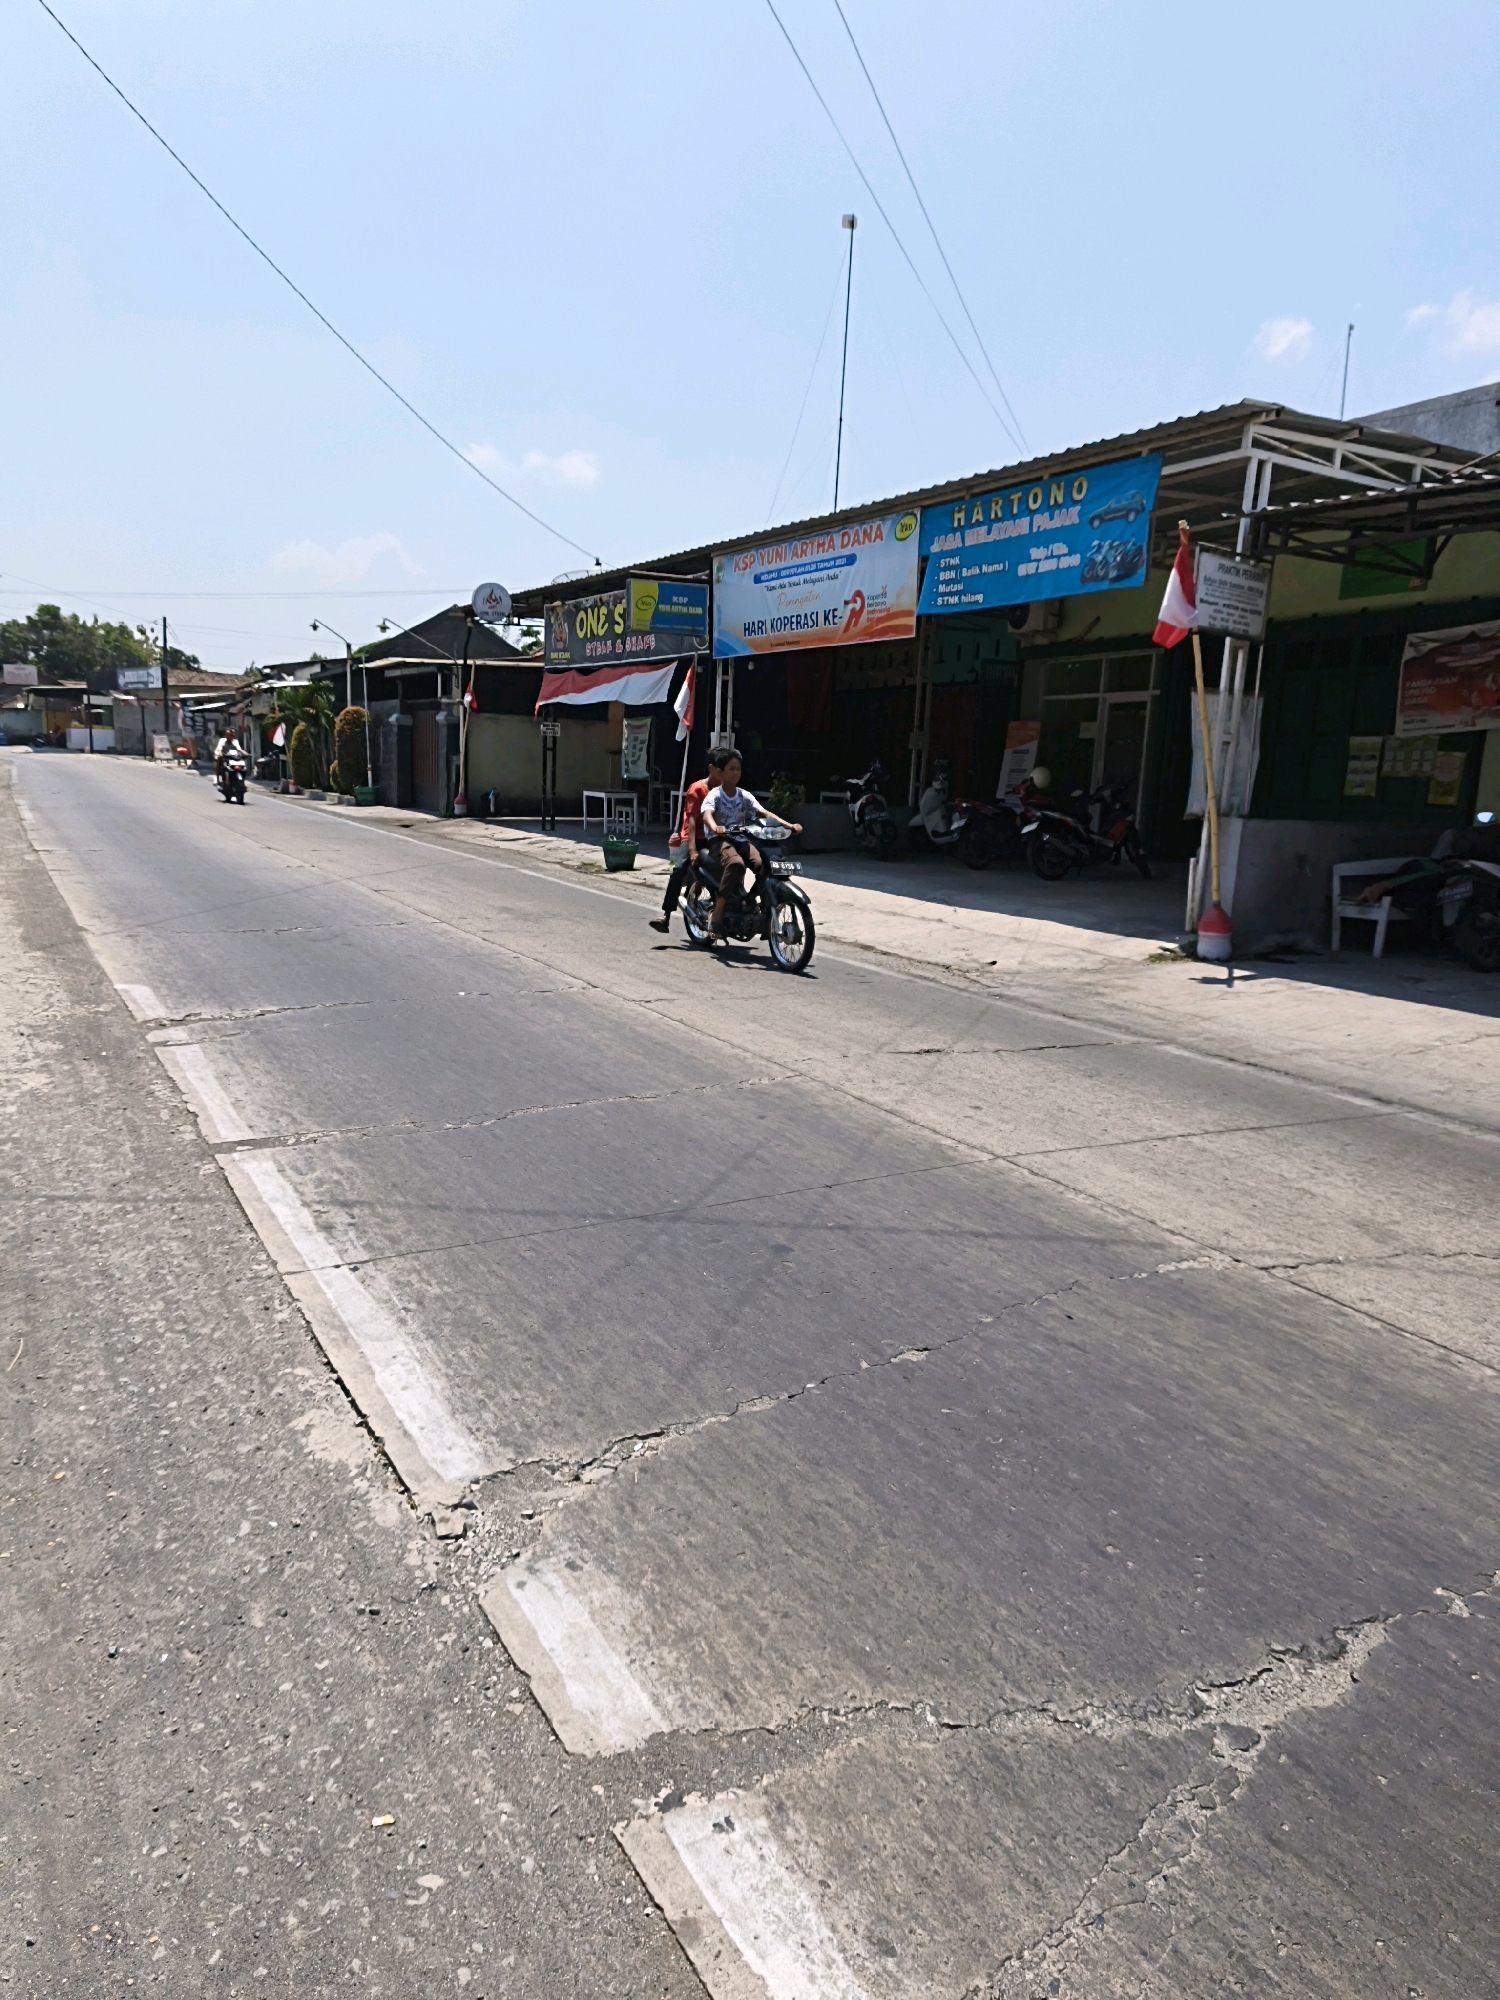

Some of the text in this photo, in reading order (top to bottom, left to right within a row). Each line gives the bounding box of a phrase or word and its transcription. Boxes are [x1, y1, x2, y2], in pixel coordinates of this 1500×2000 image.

[953, 476, 1087, 528] HARTONO
[930, 506, 1081, 552] JASA MELAYANI PAJAK
[733, 554, 756, 573] KSP
[759, 545, 788, 567] YUNI
[790, 535, 836, 560] ARTHA
[840, 522, 884, 550] DANA
[939, 570, 956, 581] BBN
[962, 566, 980, 577] Balik
[982, 563, 1003, 573] Nama
[940, 556, 960, 567] STNK
[938, 582, 963, 593] Mutasi
[672, 596, 688, 604] KSP
[937, 594, 983, 605] STNK hilang
[576, 605, 608, 639] ONE
[743, 619, 767, 637] HARI
[770, 611, 819, 633] KOPERASI
